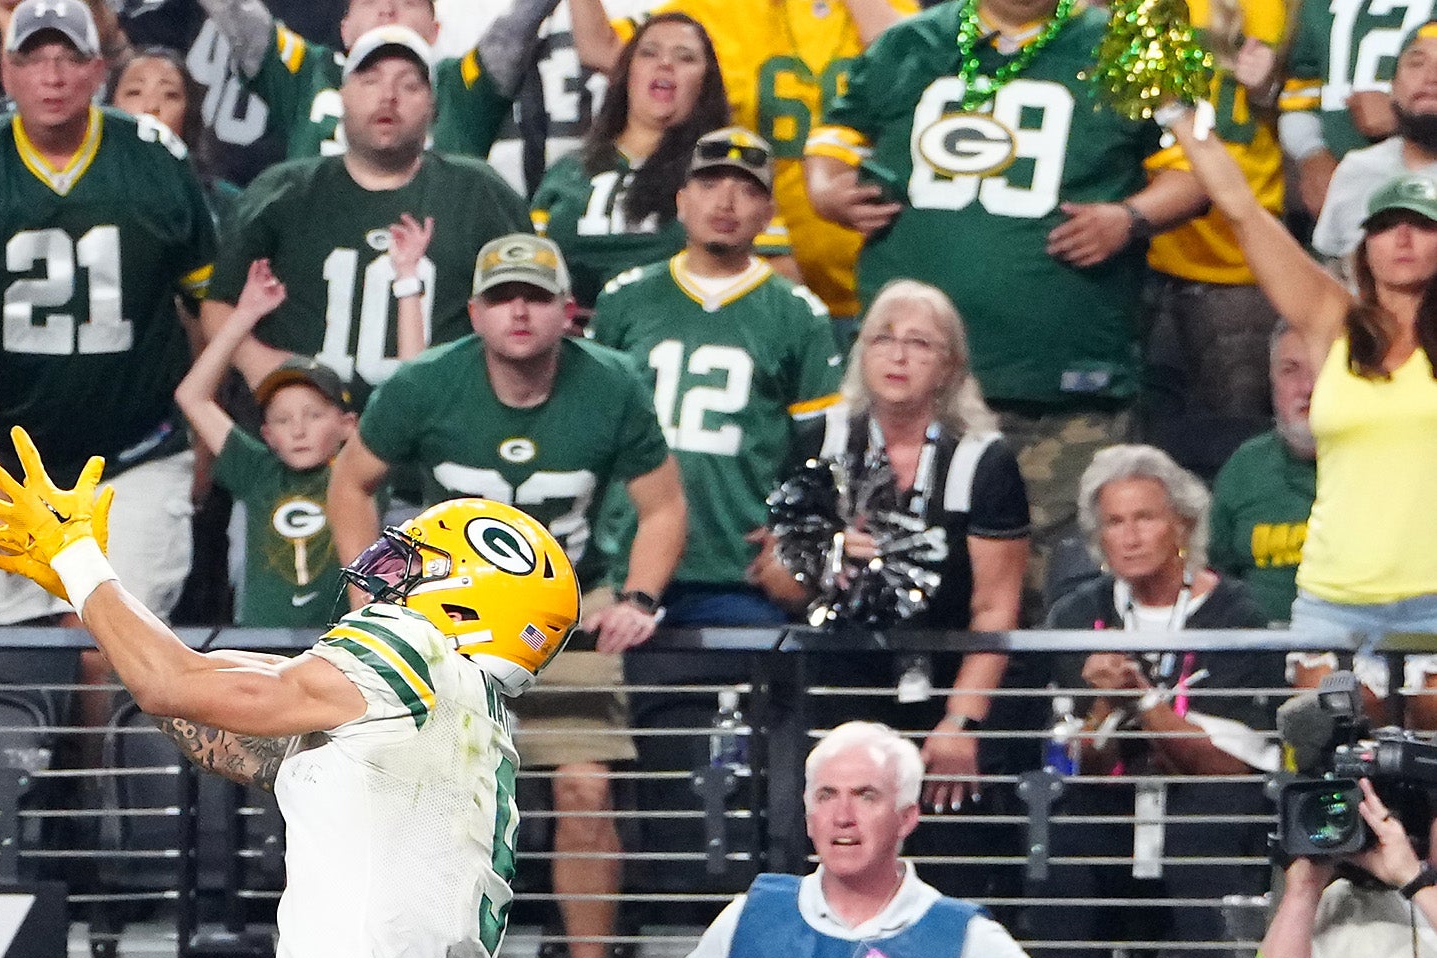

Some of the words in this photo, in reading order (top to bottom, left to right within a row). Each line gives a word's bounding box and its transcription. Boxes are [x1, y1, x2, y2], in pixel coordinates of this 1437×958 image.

[920, 115, 1017, 174] G
[3, 225, 134, 354] 21
[315, 249, 437, 385] 10
[649, 340, 754, 455] 12
[272, 500, 326, 538] G
[466, 517, 536, 575] G
